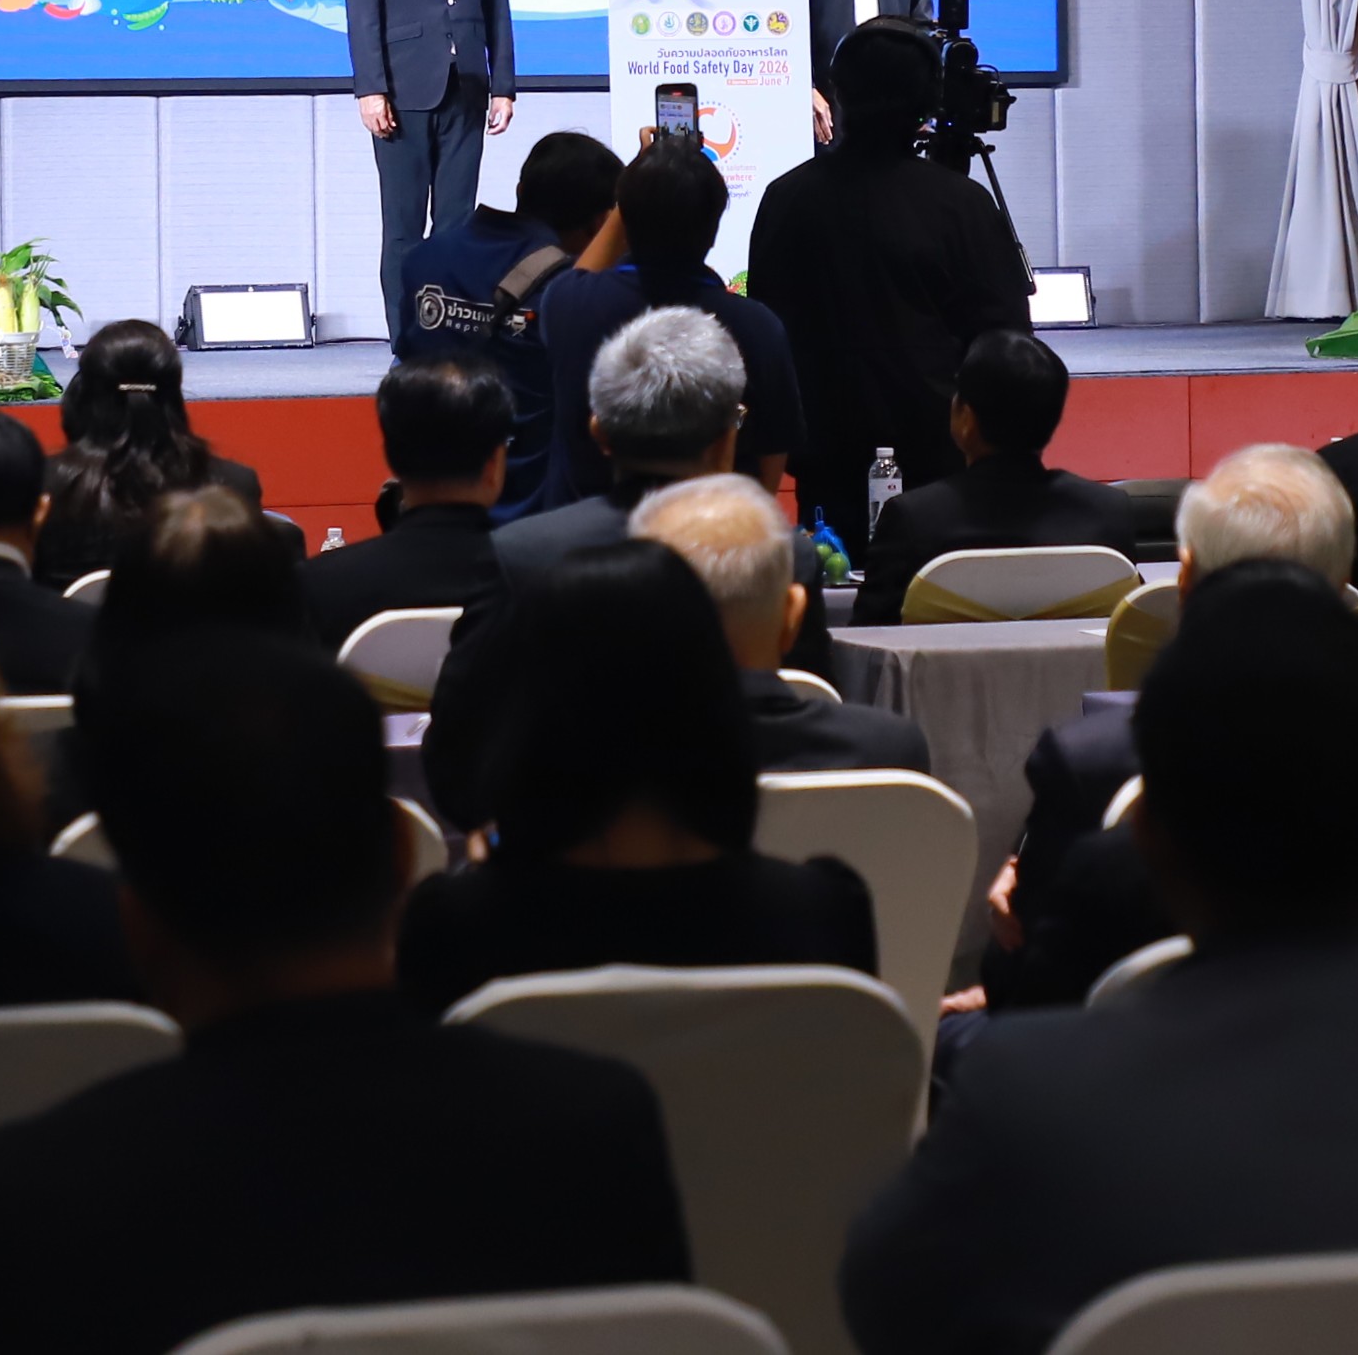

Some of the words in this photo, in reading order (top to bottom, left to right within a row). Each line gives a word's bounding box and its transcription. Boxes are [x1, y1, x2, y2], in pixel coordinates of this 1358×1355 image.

[628, 61, 660, 75] World
[663, 61, 689, 75] Food
[693, 60, 730, 77] Safety
[733, 60, 754, 76] Day
[758, 60, 789, 74] 2026
[759, 76, 782, 86] June
[784, 76, 790, 85] 7
